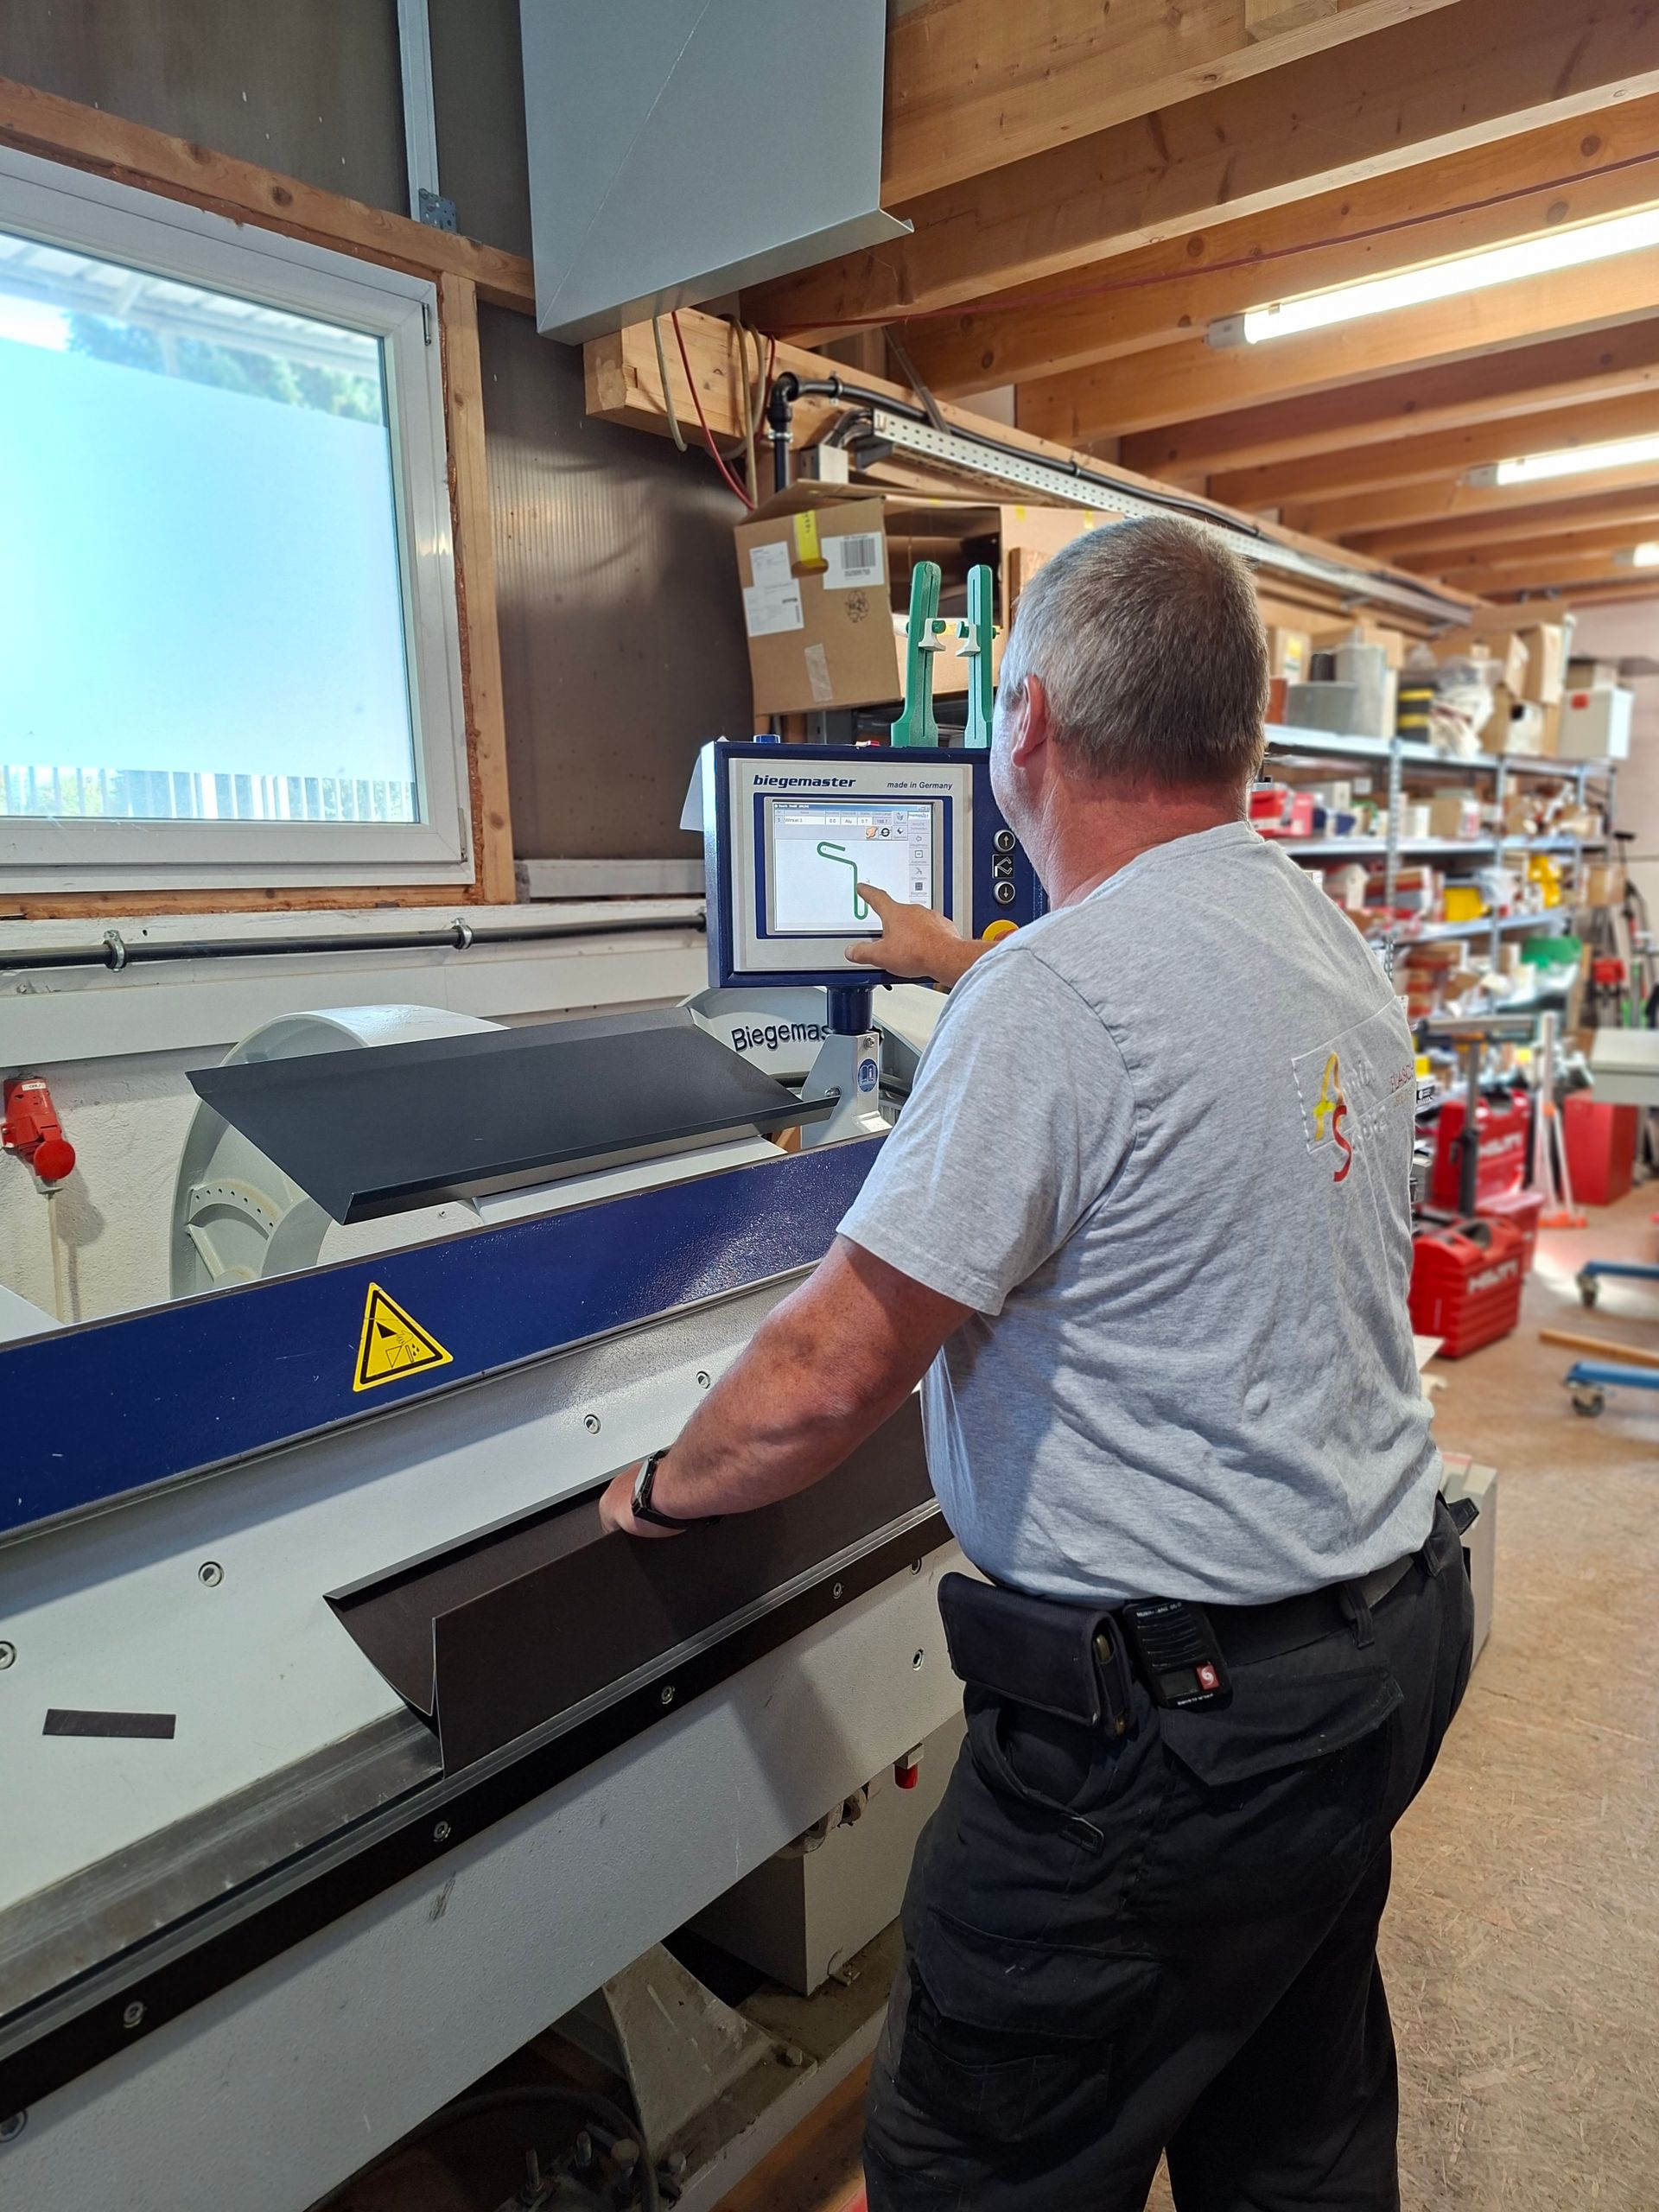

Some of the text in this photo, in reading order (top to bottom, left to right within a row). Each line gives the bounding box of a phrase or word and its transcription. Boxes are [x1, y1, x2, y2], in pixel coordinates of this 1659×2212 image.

[753, 774, 856, 788] biegemaster
[918, 781, 953, 791] Germany
[731, 1023, 835, 1052] Biegemas
[1468, 1261, 1519, 1294] HILTI
